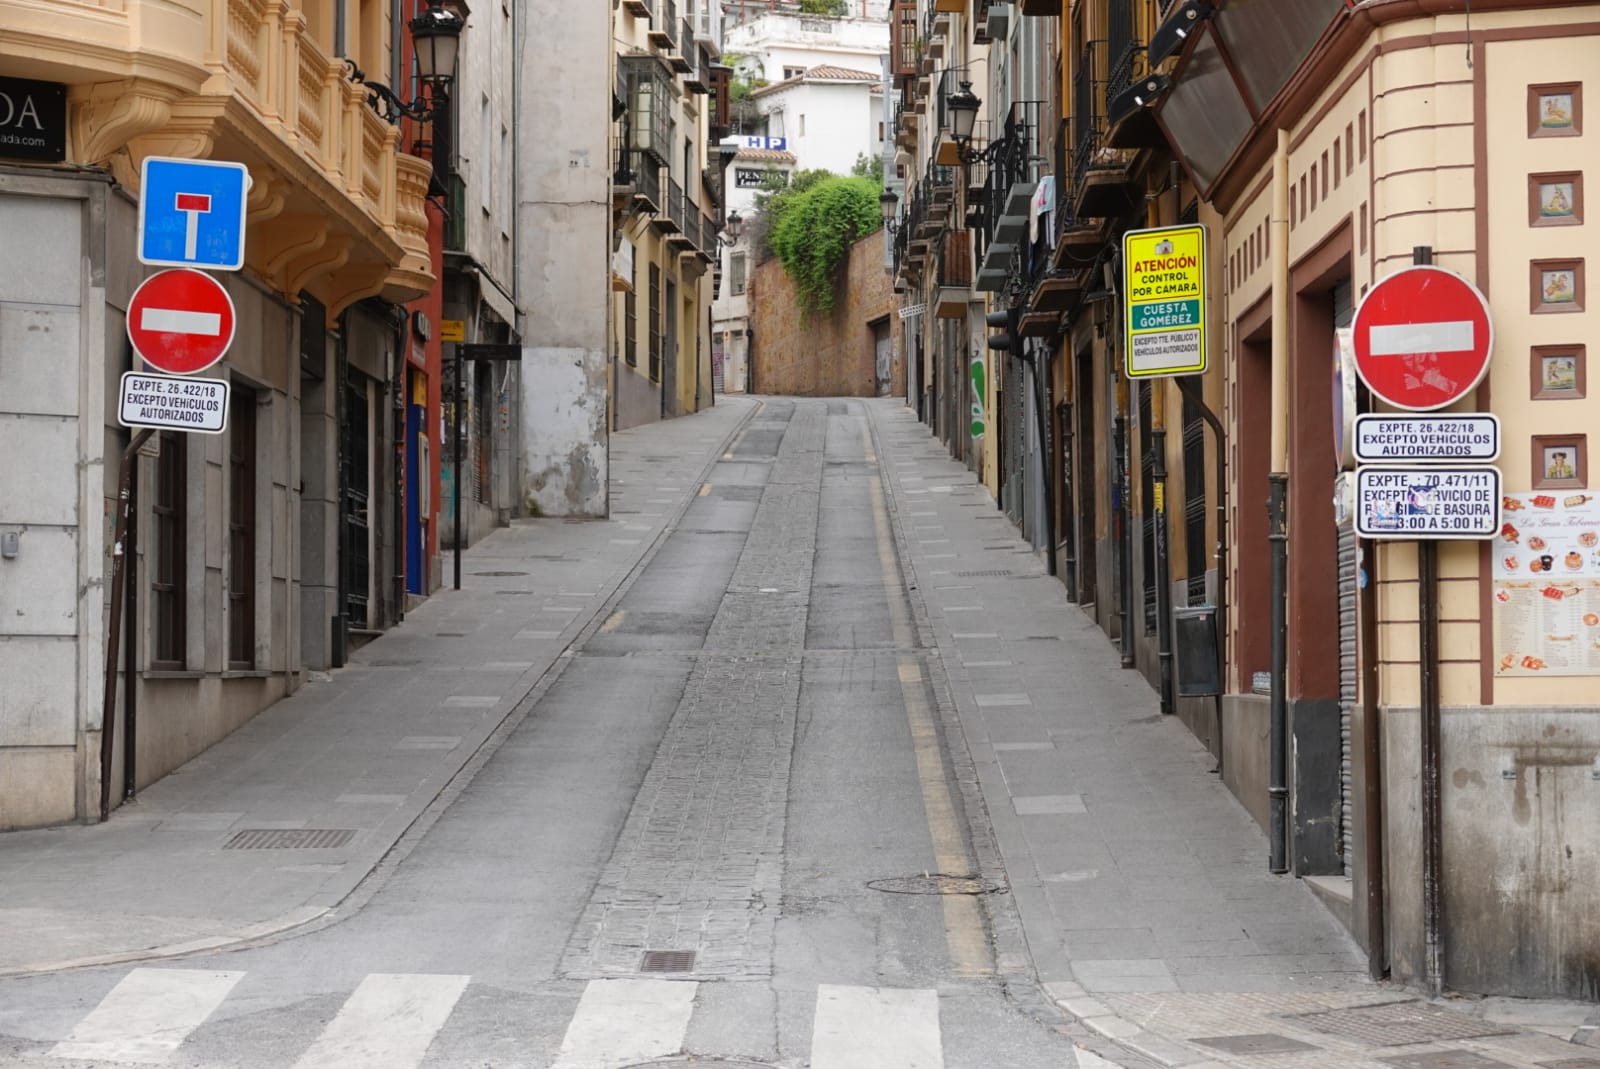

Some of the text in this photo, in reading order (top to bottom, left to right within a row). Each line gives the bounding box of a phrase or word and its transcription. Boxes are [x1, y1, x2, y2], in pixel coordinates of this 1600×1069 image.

[748, 136, 782, 149] H P
[1134, 253, 1196, 273] ATENCIÓN
[1141, 272, 1188, 284] CONTROL
[1133, 287, 1152, 296] POR
[1143, 302, 1188, 315] CUESTA
[1140, 313, 1192, 327] GOMÉREZ
[1134, 336, 1158, 346] EXCEPTO
[1163, 344, 1198, 354] AUTORIZADOS
[133, 380, 216, 397] EXPTE. 26.422/18
[127, 393, 167, 406] EXCEPTO
[140, 407, 204, 423] AUTORIZADOS
[1379, 423, 1474, 433] EXPTE. 26.422/18
[1363, 434, 1418, 444] EXCEPTO
[1382, 445, 1472, 455] AUTORIZADOS
[1424, 475, 1488, 487] 70.471/11
[1364, 490, 1414, 502] EXCEPT
[1475, 490, 1490, 502] DE
[1444, 504, 1490, 516] BASURA
[1429, 517, 1441, 529] A
[1441, 517, 1470, 529] 5:00
